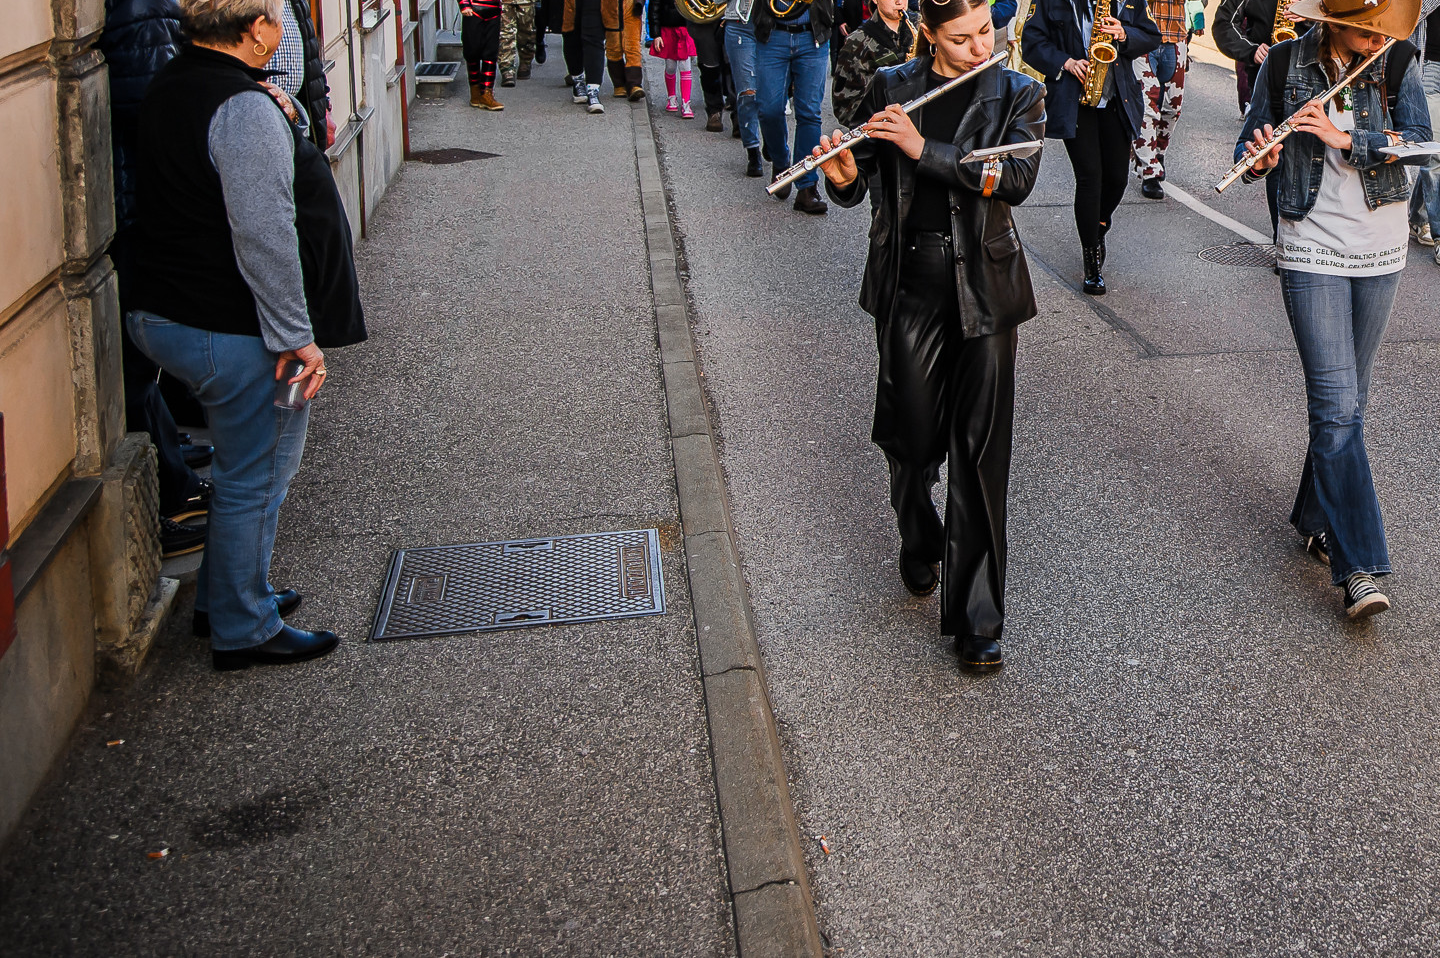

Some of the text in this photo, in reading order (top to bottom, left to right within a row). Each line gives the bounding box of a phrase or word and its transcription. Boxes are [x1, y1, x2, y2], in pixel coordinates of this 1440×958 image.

[1285, 244, 1312, 253] CELTICS
[1316, 248, 1345, 259] CELTICS
[1348, 252, 1377, 260] CELTICS
[1379, 246, 1401, 257] CELTICS
[1315, 259, 1345, 269] CELTICS
[1377, 256, 1401, 267] CELTICS
